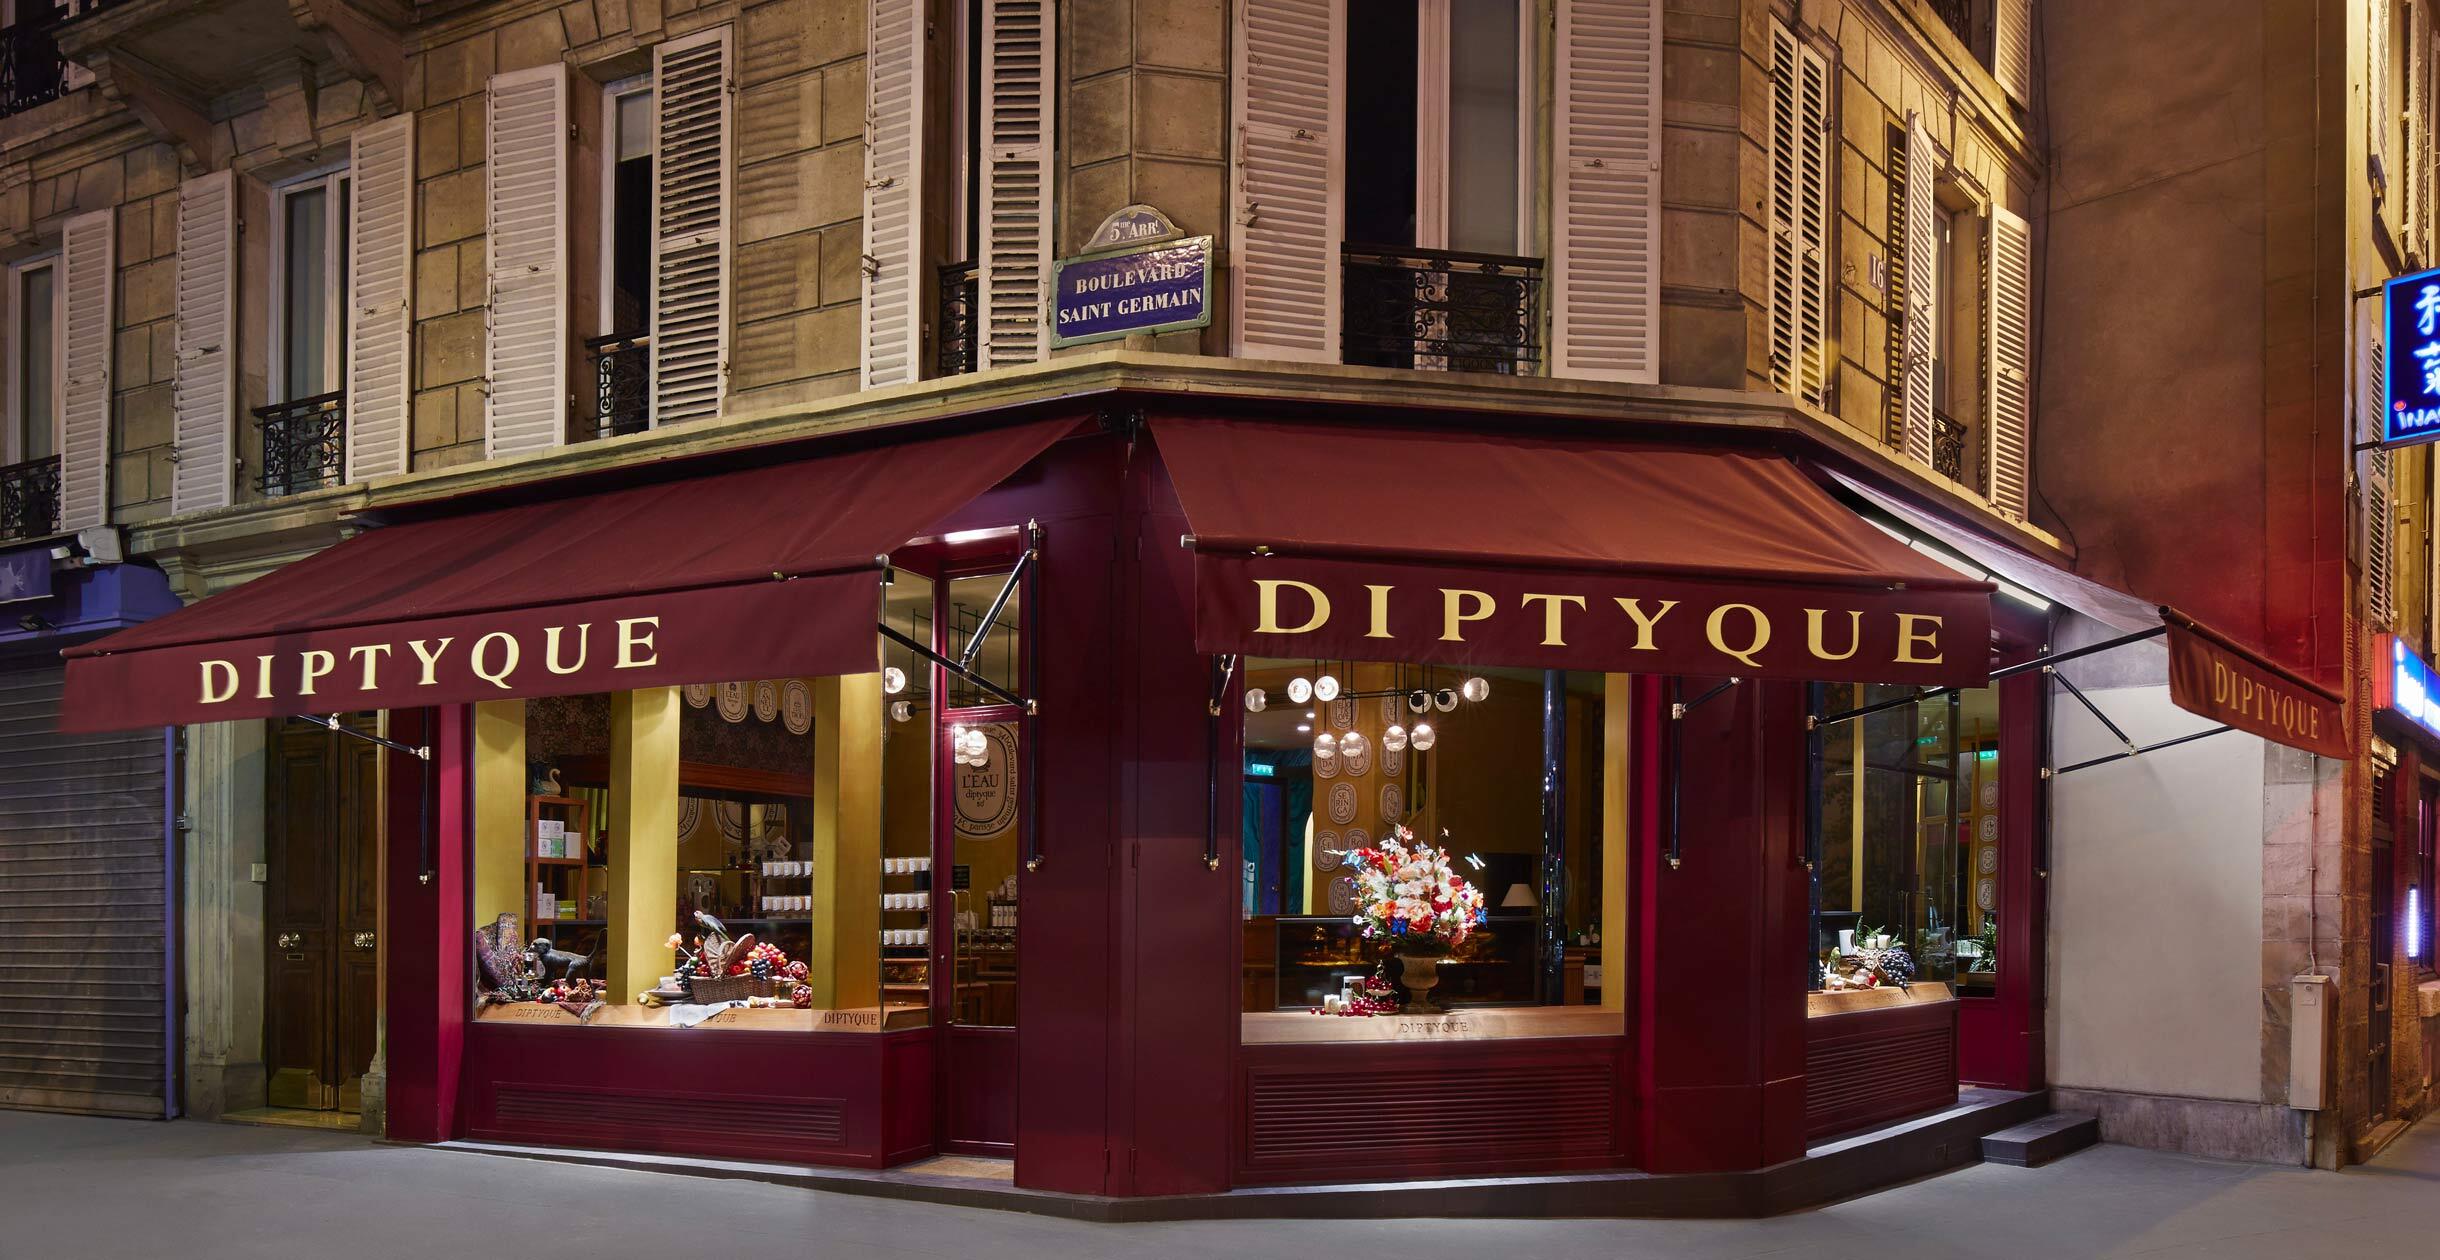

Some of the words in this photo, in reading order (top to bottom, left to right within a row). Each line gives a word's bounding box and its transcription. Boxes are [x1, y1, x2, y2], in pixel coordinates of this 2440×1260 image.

[1076, 263, 1186, 294] BOULEVARD
[1872, 256, 1884, 288] 16
[1060, 302, 1112, 324] SAINT
[1117, 287, 1201, 315] GERMAIN
[1252, 579, 1944, 669] DIPTYQUE
[198, 615, 660, 704] DIPTYQUE
[2215, 661, 2320, 740] DIPTYQUE
[962, 774, 999, 788] L'EAU
[1009, 775, 1017, 795] saint
[965, 789, 996, 800] diptyque
[1336, 806, 1348, 814] GA
[515, 1008, 561, 1019] DIPTYQUE
[824, 1012, 877, 1025] DIPTYQUE
[1400, 1022, 1469, 1033] DIPTYQUE
